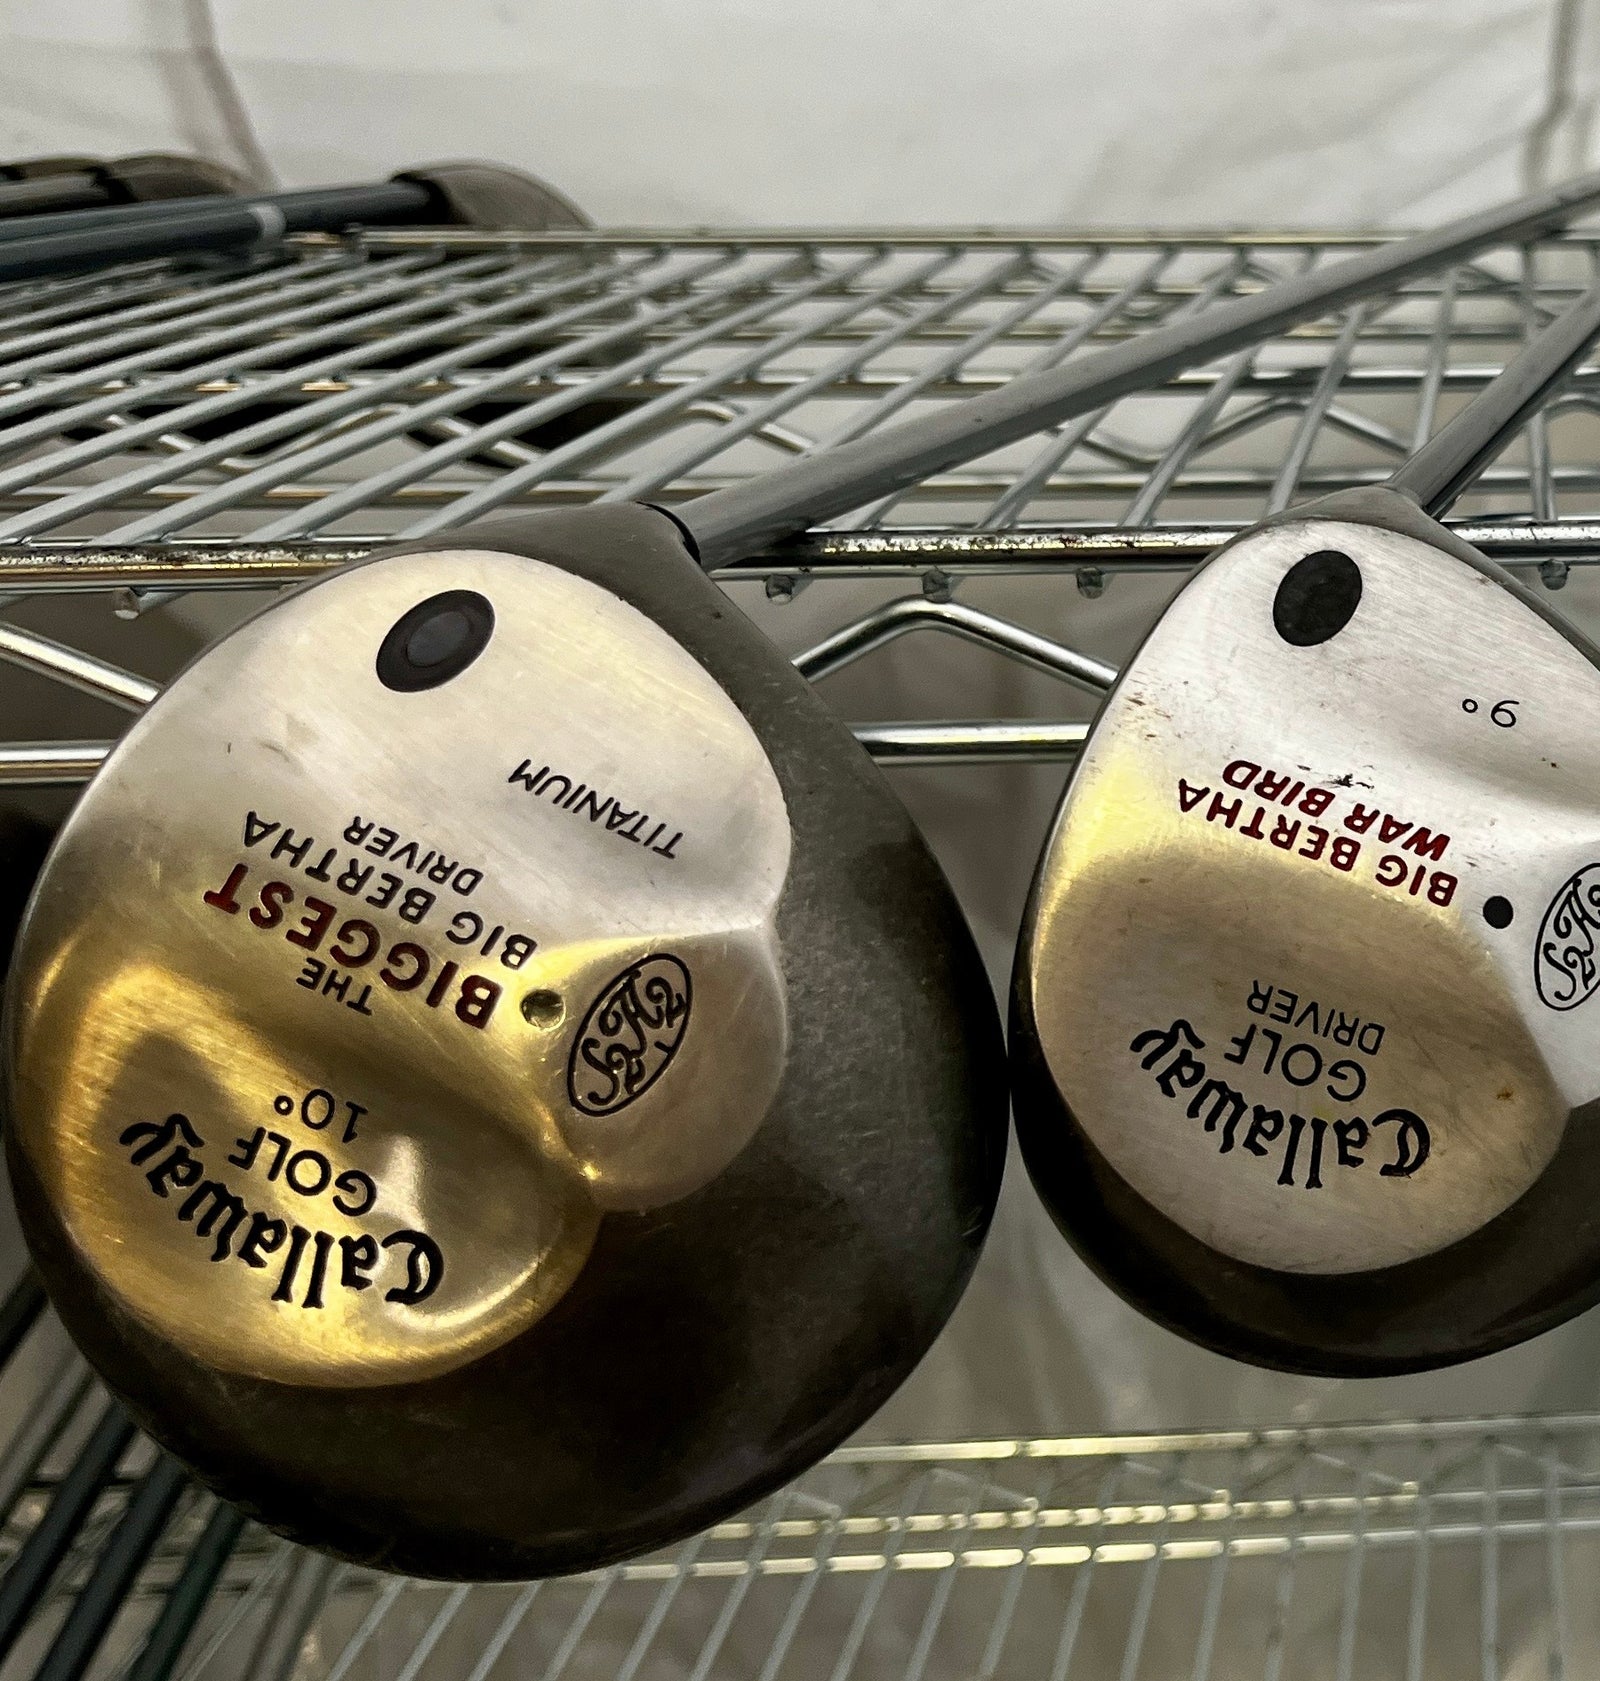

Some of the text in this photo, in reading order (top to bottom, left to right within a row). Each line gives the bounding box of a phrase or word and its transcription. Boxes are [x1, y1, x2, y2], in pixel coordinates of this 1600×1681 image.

[343, 815, 482, 895] DRIVER
[508, 759, 686, 859] TITANIUM
[1178, 778, 1459, 908] BIG BERTHA
[1223, 759, 1451, 862] WAR BIRD
[243, 811, 538, 971] BIG BERTHA
[203, 862, 501, 1028] BIGGEST
[296, 957, 373, 1017] THE
[1224, 1023, 1367, 1102] GOLF
[1246, 978, 1386, 1057] DRIVER
[1130, 1018, 1432, 1190] Callaway
[120, 1112, 444, 1308] Callaway
[228, 1125, 378, 1217] GOLF
